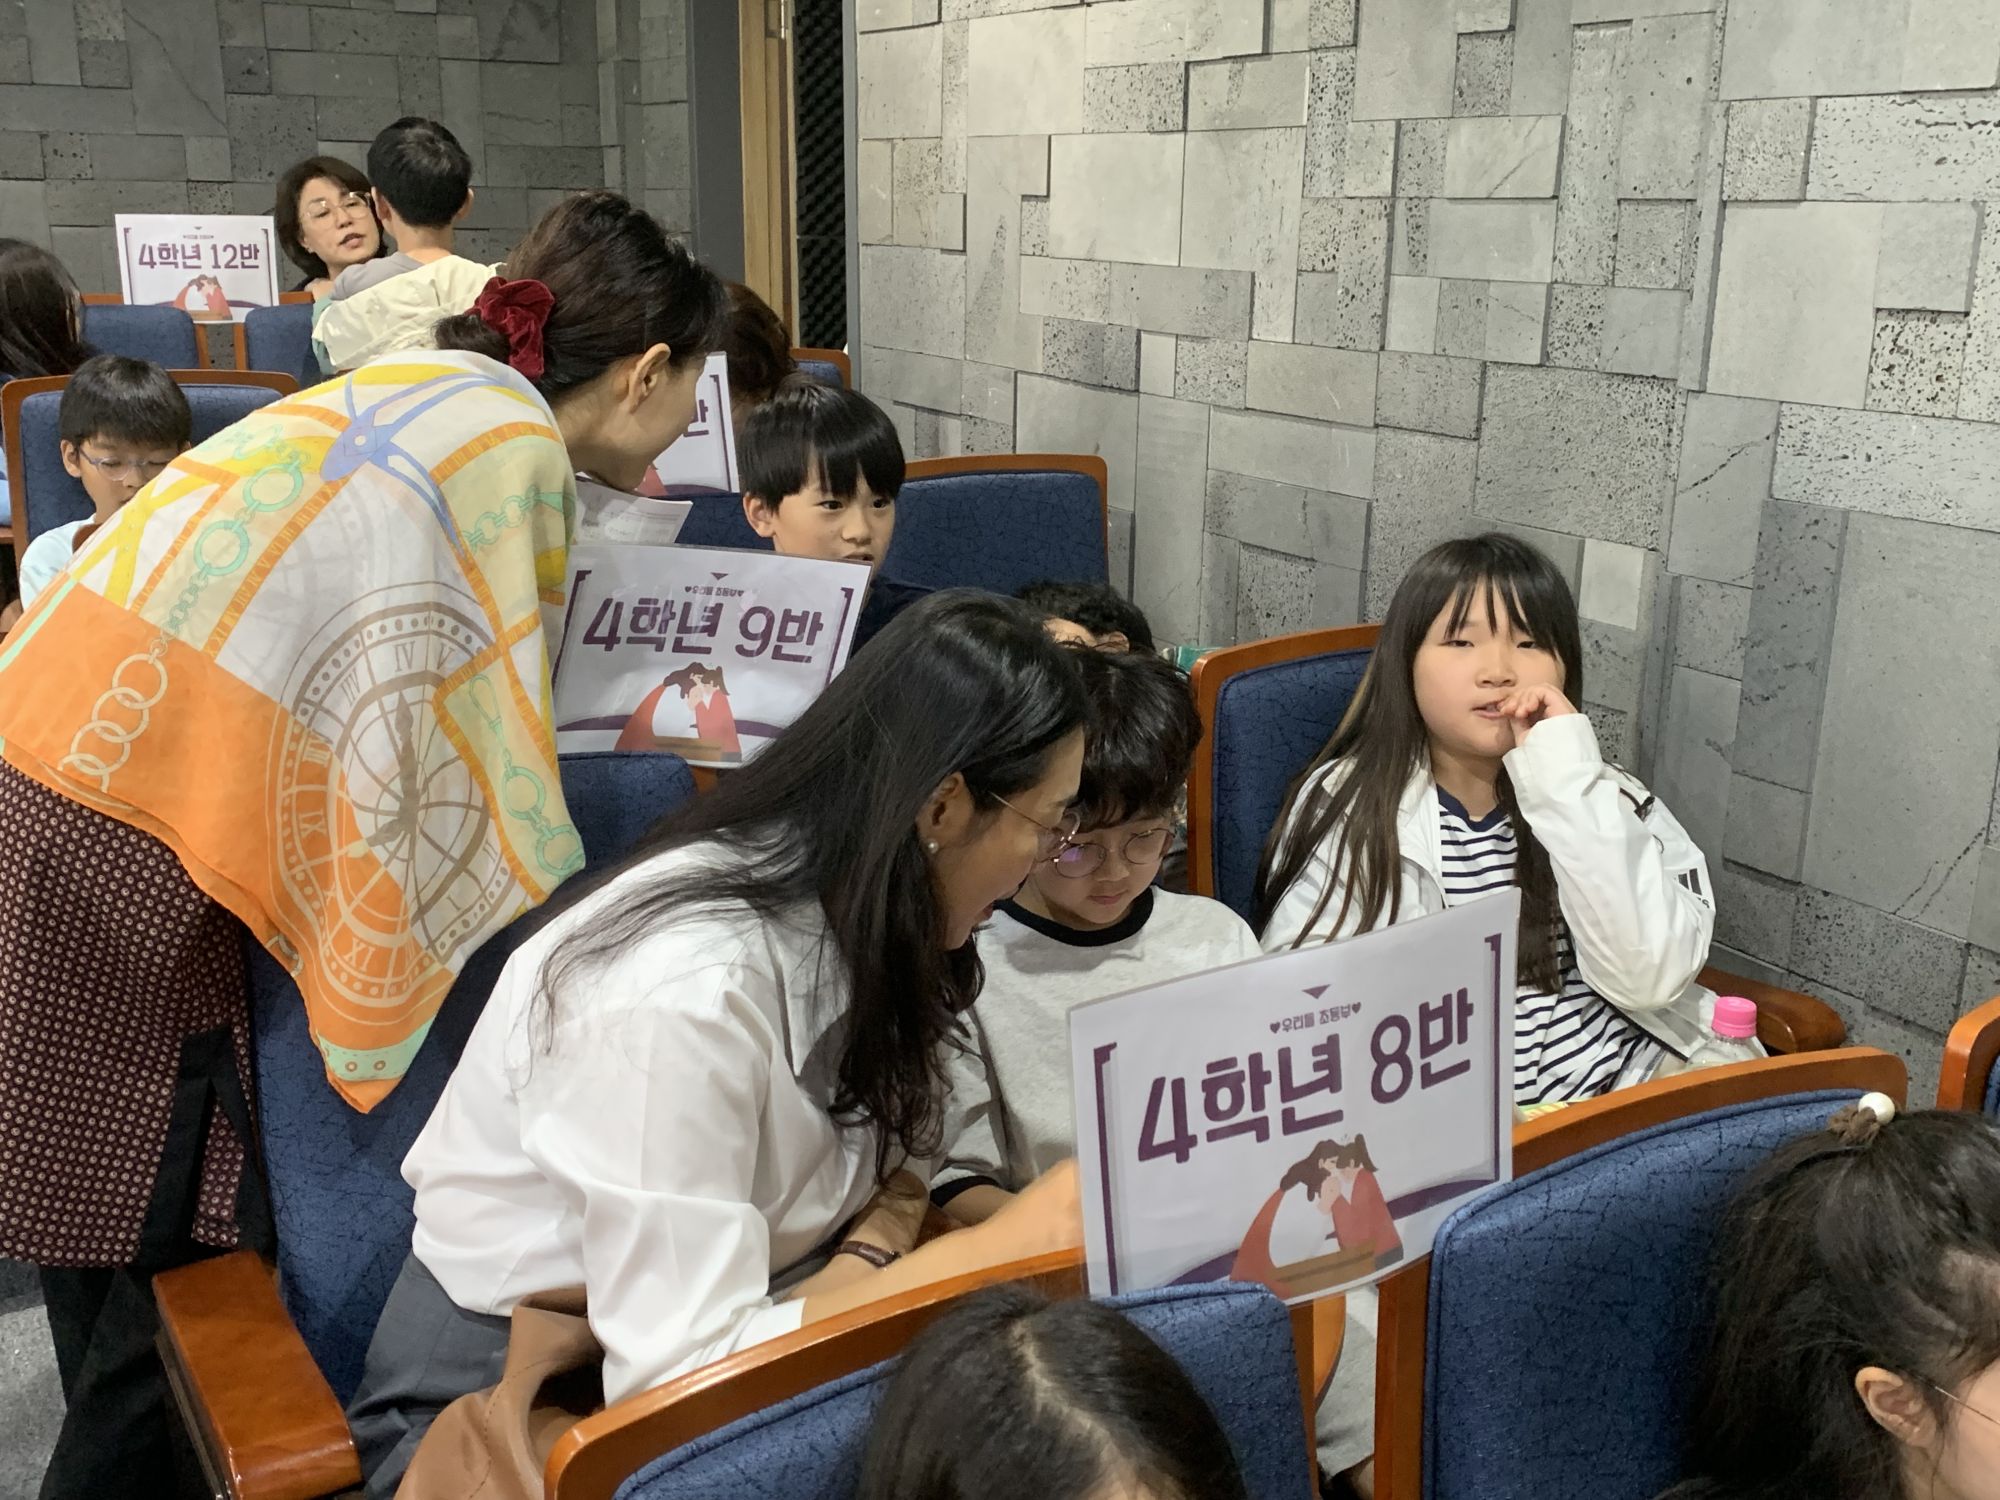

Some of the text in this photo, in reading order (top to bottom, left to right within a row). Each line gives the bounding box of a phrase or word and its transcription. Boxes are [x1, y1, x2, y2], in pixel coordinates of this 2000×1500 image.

[138, 243, 260, 270] 4학년 12반
[582, 597, 824, 664] 4학년 9반
[1281, 1011, 1316, 1033] 우리들
[1138, 986, 1475, 1164] 4학년 8반
